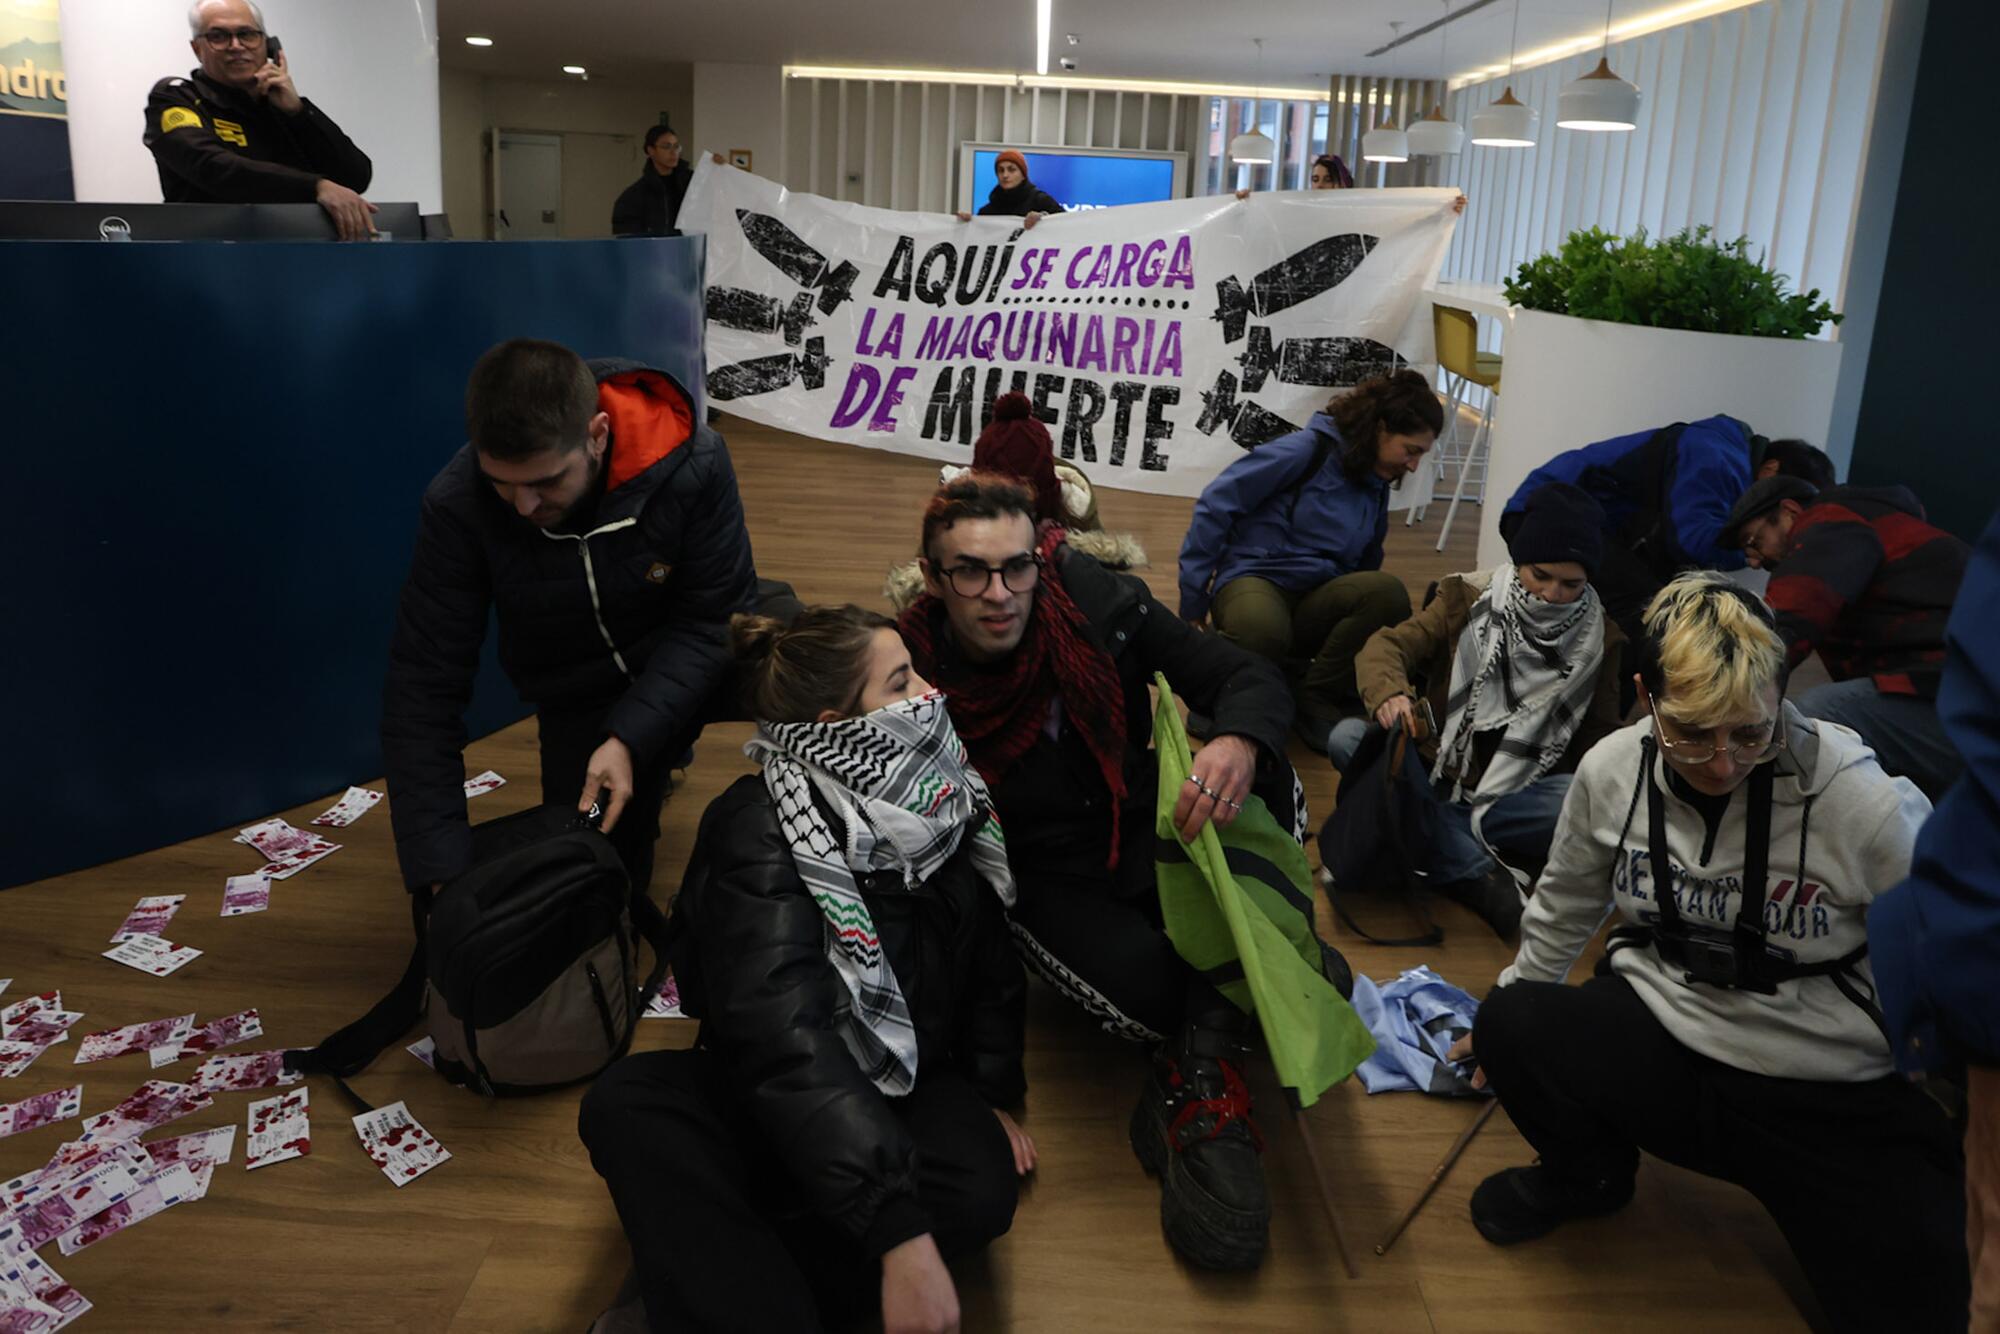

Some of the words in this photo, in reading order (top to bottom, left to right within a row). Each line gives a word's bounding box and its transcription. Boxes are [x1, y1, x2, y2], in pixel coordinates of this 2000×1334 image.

[873, 228, 1024, 307] AQUÍ
[1010, 247, 1060, 290] SE
[1064, 235, 1195, 290] CARGA
[855, 307, 905, 360] LA
[914, 310, 1183, 377] MAQUINARIA
[829, 361, 918, 433] DE
